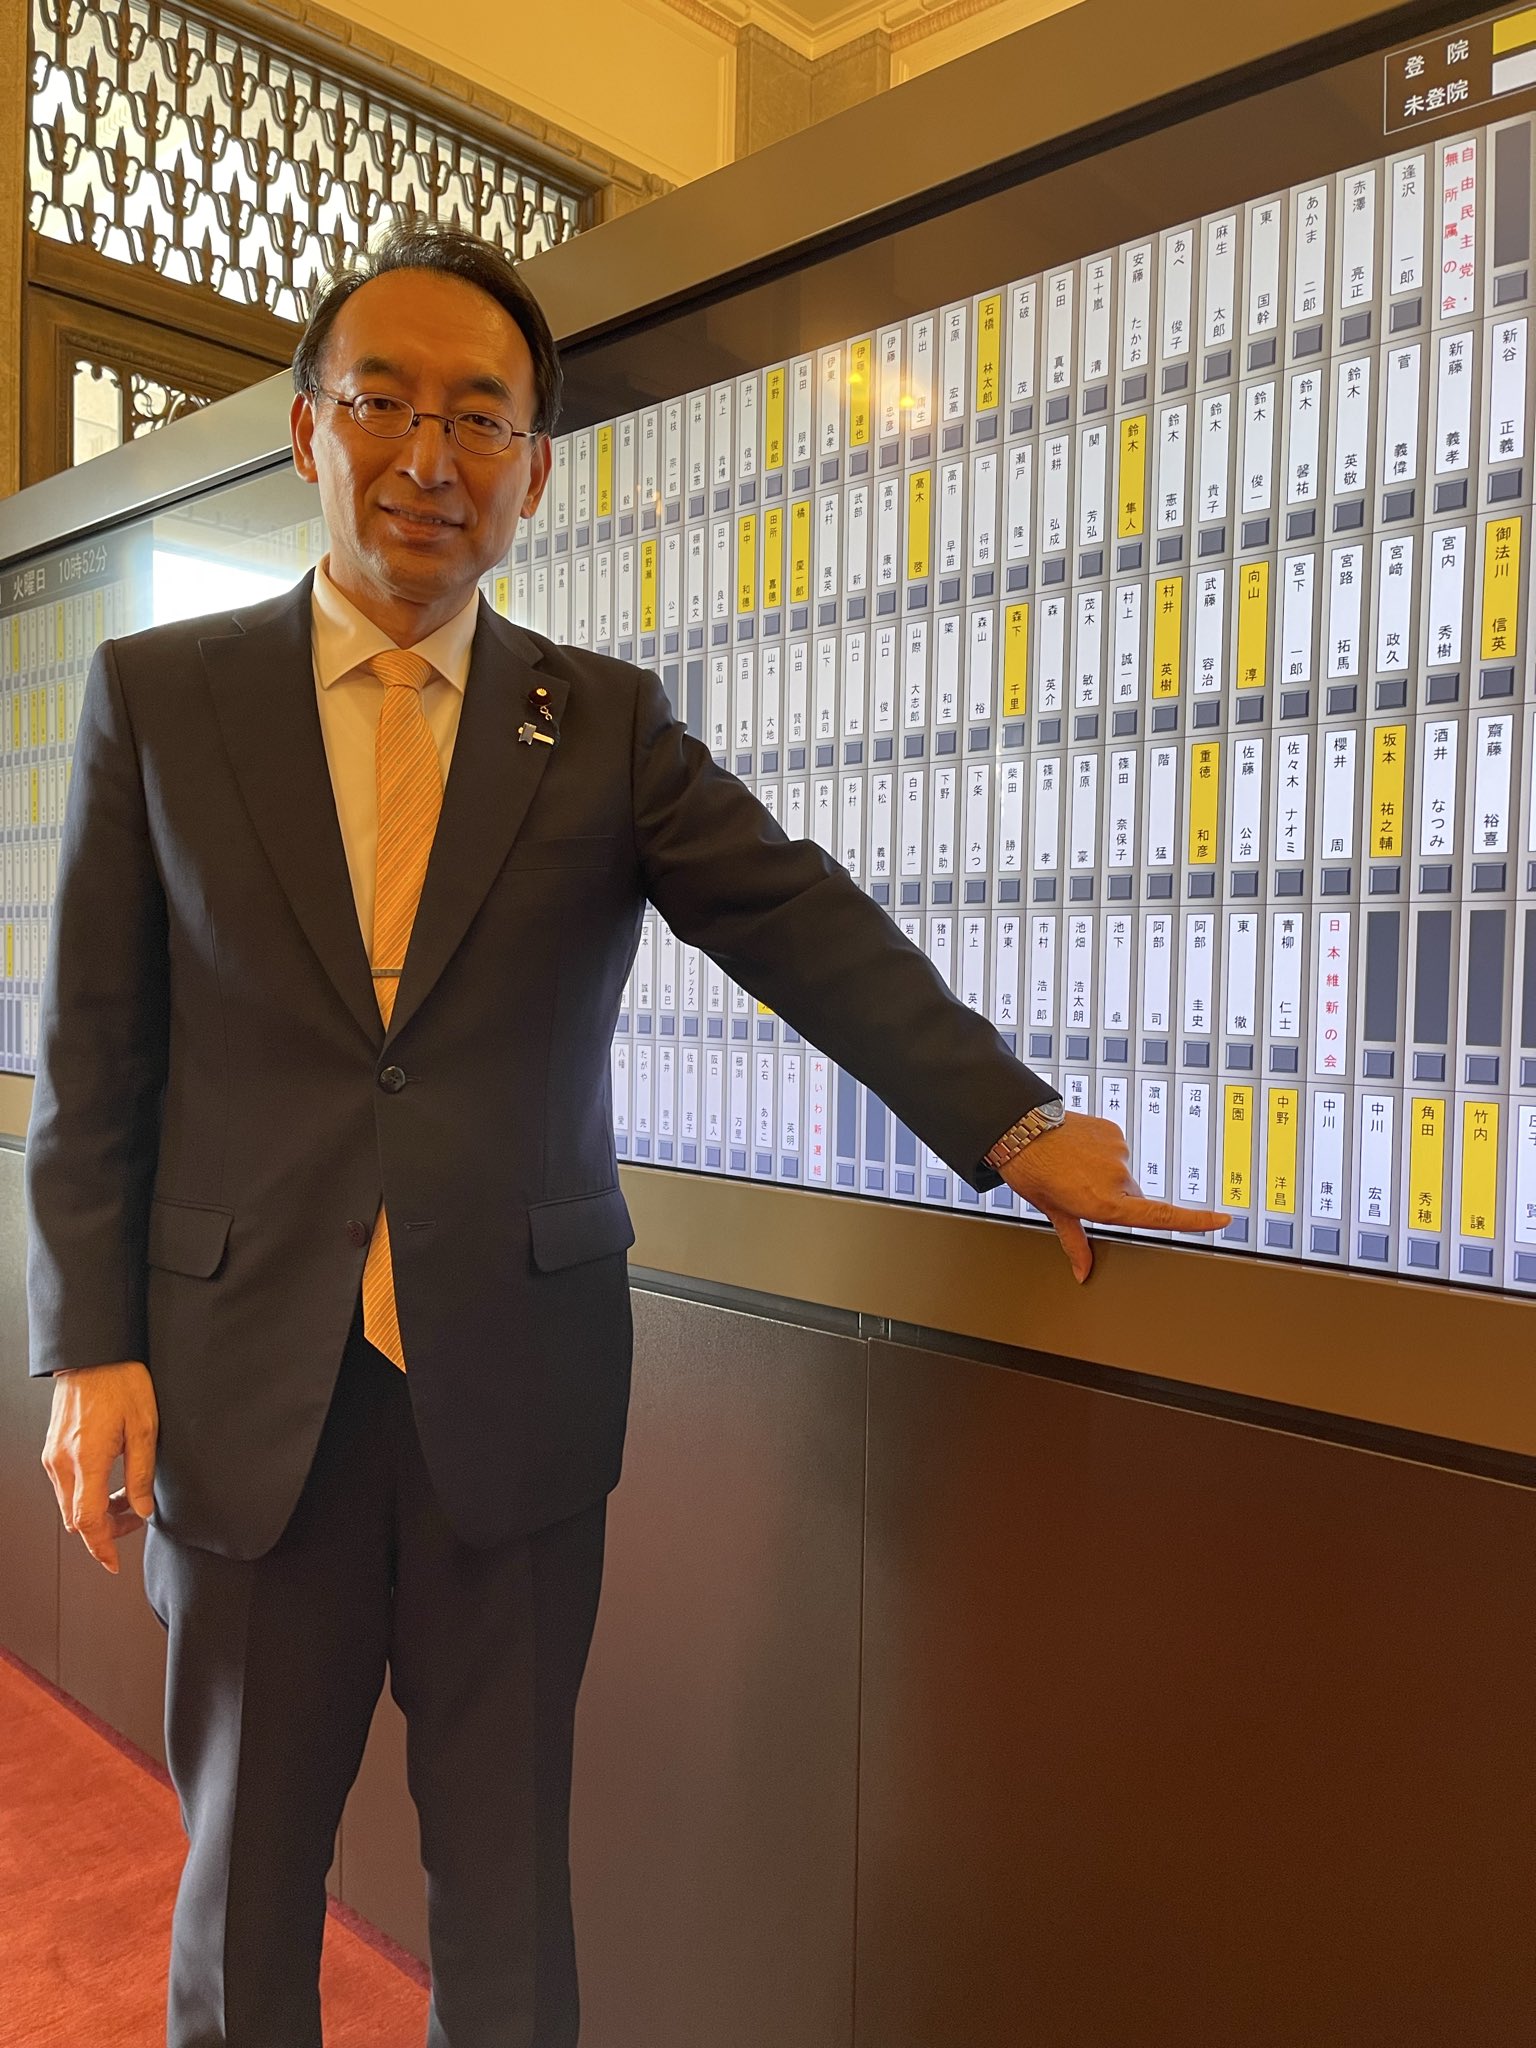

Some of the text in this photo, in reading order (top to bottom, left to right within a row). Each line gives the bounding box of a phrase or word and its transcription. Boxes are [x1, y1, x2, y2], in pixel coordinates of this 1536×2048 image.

[1403, 79, 1469, 118] 未登院
[1256, 209, 1273, 326] 東 国幹
[1302, 195, 1319, 312] あかま 二郎
[1399, 163, 1417, 285] 逢沢 一郎
[1442, 152, 1460, 311] 無所属の会
[950, 314, 961, 343] 石原
[1055, 278, 1067, 308] 石田
[1090, 265, 1105, 374] 五十嵐 清
[1130, 252, 1145, 363] 安藤 たかお
[1170, 239, 1186, 350] あべ 俊子
[1212, 224, 1229, 338] 麻生 太郎
[1350, 265, 1365, 299] 亮正
[982, 303, 995, 404] 石橋 林太郎
[1016, 290, 1030, 395] 石破 茂
[1298, 378, 1313, 411] 鈴木
[1499, 327, 1519, 455] 新谷 正義
[1250, 390, 1267, 500] 鈴木 俊一
[1343, 366, 1362, 486] 鈴木 英敬
[1392, 353, 1412, 476] 菅 義偉
[1444, 340, 1464, 465] 新藤 義孝
[981, 460, 991, 473] 平
[1015, 451, 1026, 481] 瀬戸
[1049, 442, 1063, 546] 世耕 弘成
[1086, 432, 1100, 539] 関 芳弘
[1125, 423, 1140, 531] 鈴木 隼人
[1164, 413, 1180, 523] 鈴木 憲和
[1206, 401, 1223, 514] 鈴木 貴子
[13, 544, 108, 601] 火曜日 10時52分
[743, 521, 751, 544] 田中
[945, 539, 956, 567] 早苗
[1159, 583, 1175, 692] 村井 英樹
[1201, 576, 1217, 687] 武藤 容治
[1244, 569, 1260, 682] 向山 淳
[1289, 562, 1307, 676] 宮下 一郎
[1336, 553, 1354, 671] 宮路 拓馬
[1436, 535, 1457, 659] 宮内 秀樹
[1491, 526, 1512, 652] 御法川 信英
[767, 653, 776, 676] 山本
[794, 648, 803, 672] 山田
[822, 643, 831, 667] 山下
[851, 638, 860, 663] 山口
[881, 633, 891, 658] 山口
[974, 616, 988, 715] 森山 裕
[1009, 610, 1022, 711] 森下 千里
[1045, 604, 1058, 706] 森 英介
[1081, 597, 1096, 702] 茂木 敏充
[1120, 590, 1135, 696] 村上 誠一郎
[1385, 632, 1401, 665] 政久
[942, 692, 953, 719] 和生
[906, 776, 918, 866] 白石 洋一
[940, 774, 950, 800] 下野
[970, 770, 984, 866] 下条 みつ
[1005, 767, 1018, 866] 柴田 勝之
[1115, 818, 1128, 861] 奈保子
[1155, 753, 1171, 860] 階 猛
[1196, 749, 1212, 858] 重徳 和彦
[1239, 745, 1255, 856] 佐藤 公治
[1284, 740, 1301, 854] 佐々木 ナオミ
[1330, 736, 1348, 853] 櫻井 周
[1378, 732, 1398, 851] 坂本 祐之輔
[1429, 727, 1449, 848] 酒井 なつみ
[1482, 813, 1500, 847] 裕喜
[1040, 852, 1051, 865] 孝
[969, 923, 979, 948] 井上
[1001, 922, 1014, 1019] 伊東 信久
[1036, 921, 1050, 1021] 市村 浩一郎
[1072, 921, 1087, 1023] 池畑 浩太朗
[1111, 920, 1125, 1024] 池下 卓
[1151, 920, 1166, 1026] 阿部 司
[1191, 920, 1207, 1028] 阿部 圭史
[1234, 919, 1250, 1029] 東 徹
[1278, 919, 1295, 1030] 青柳 仁士
[1324, 919, 1341, 1069] 日本維新の会
[760, 1059, 769, 1142] 大石 あきこ
[787, 1060, 796, 1084] 上村
[813, 1061, 823, 1176] れいわ新選組
[1071, 1079, 1083, 1108] 福重
[1109, 1083, 1120, 1111] 平林
[1421, 1105, 1435, 1137] 角田
[1146, 1162, 1159, 1185] 雅一
[1187, 1089, 1202, 1196] 沼崎 満子
[1230, 1092, 1245, 1201] 西園 勝秀
[1274, 1095, 1290, 1207] 中野 洋昌
[1319, 1098, 1336, 1212] 中川 康洋
[1367, 1101, 1385, 1218] 中川 宏昌
[1473, 1108, 1489, 1142] 竹内
